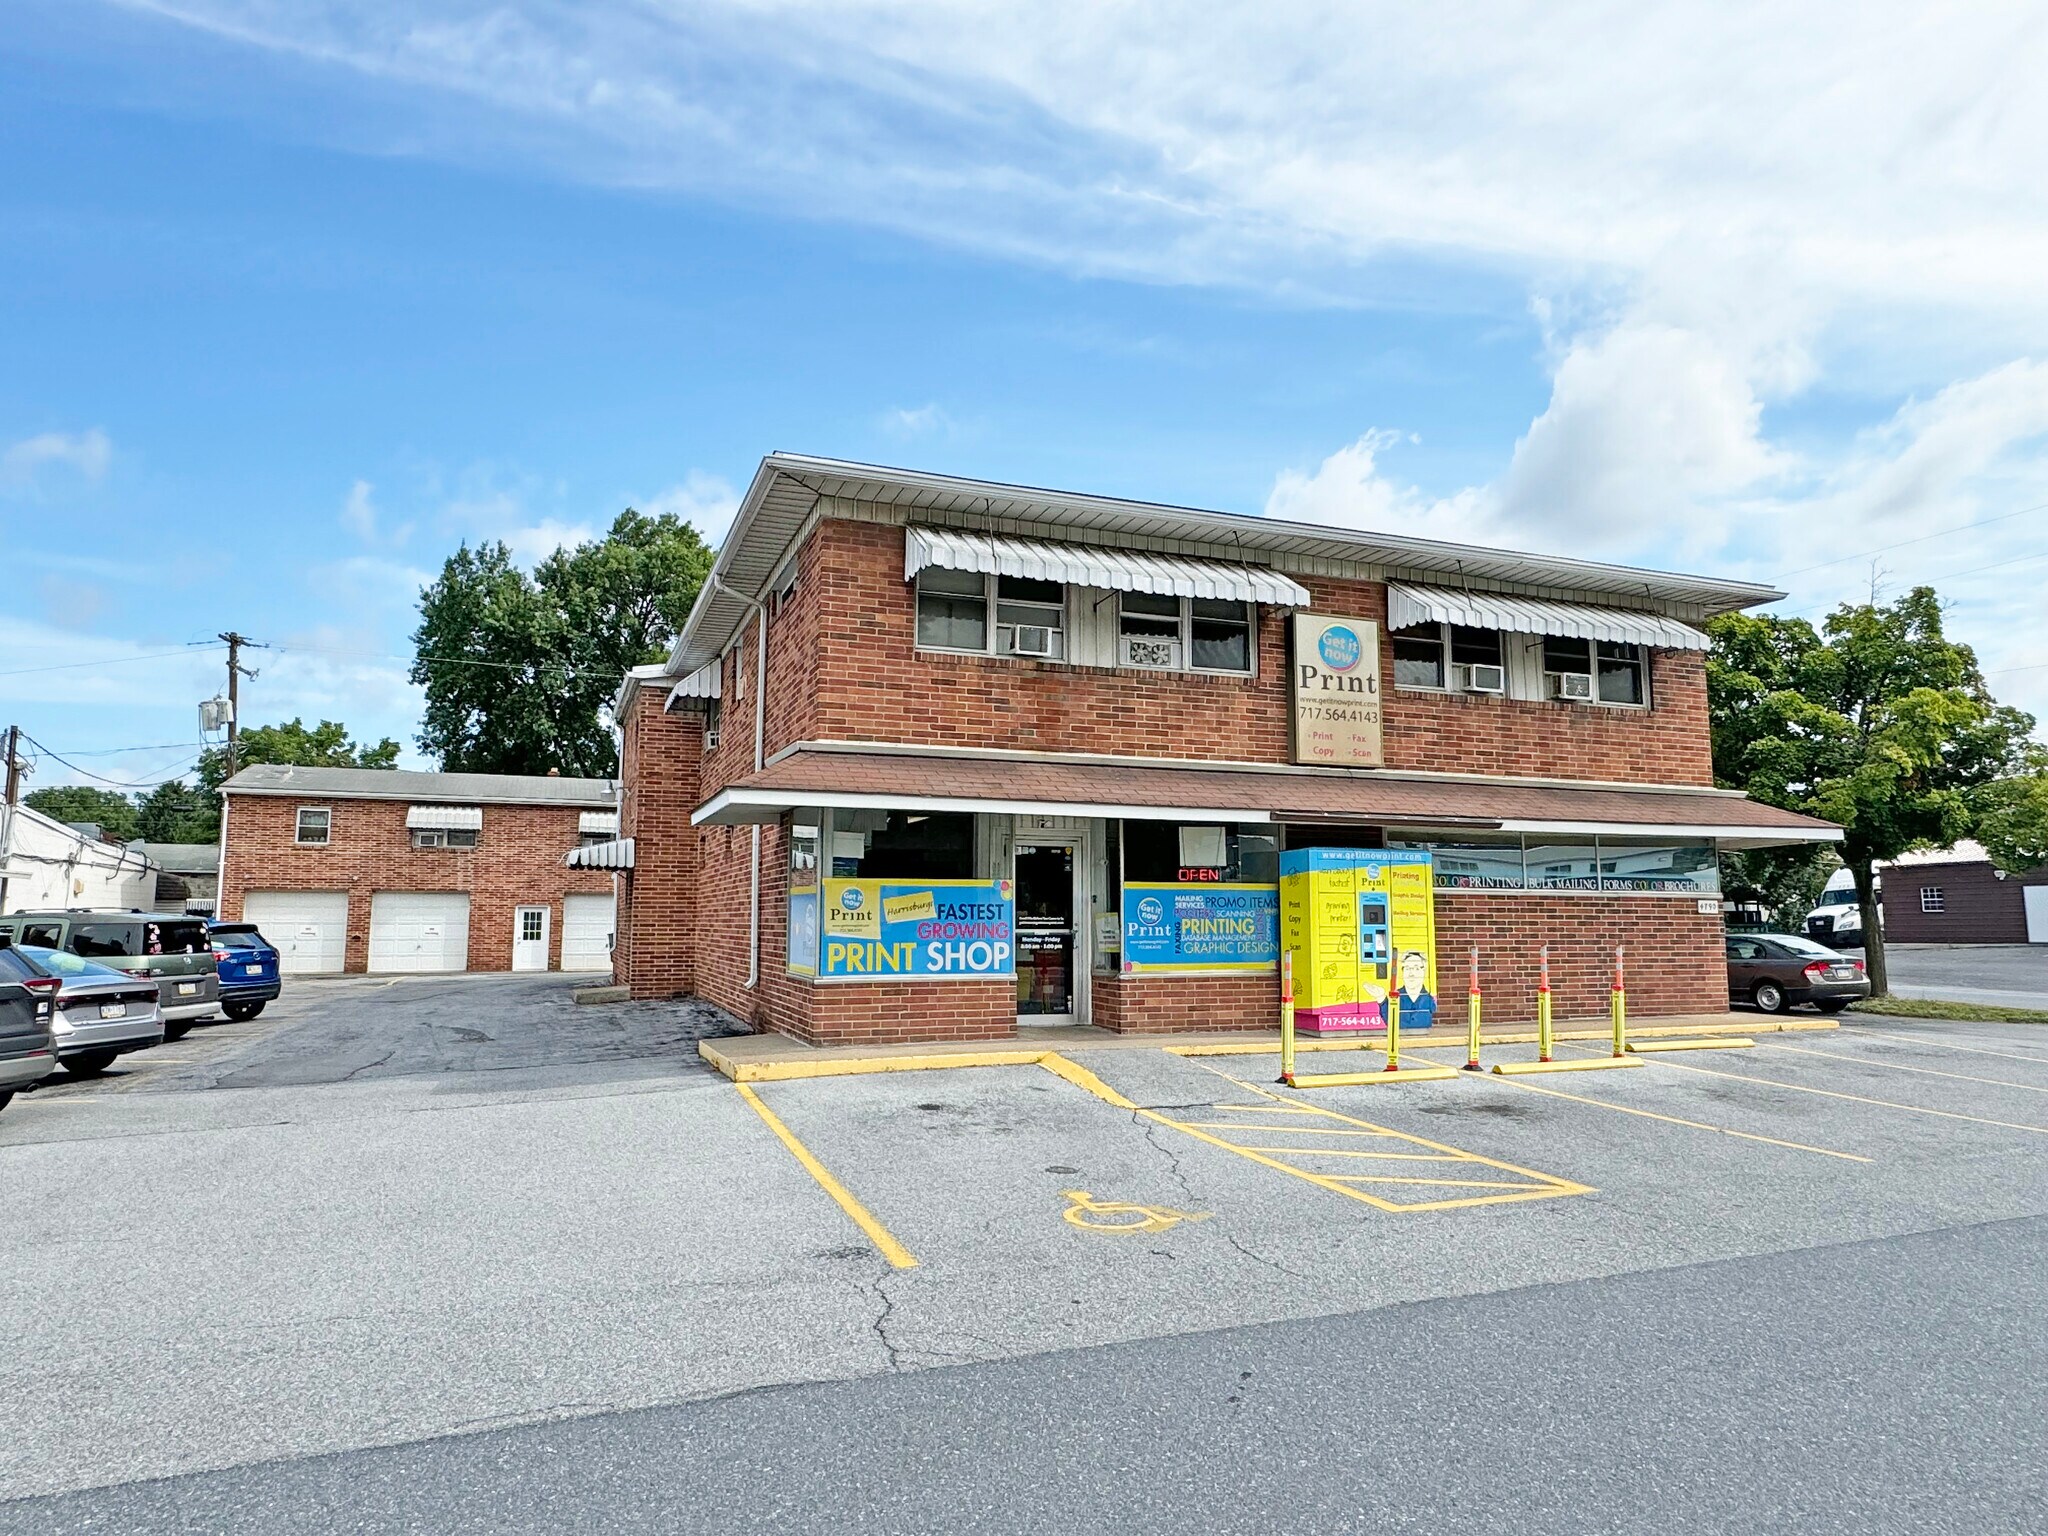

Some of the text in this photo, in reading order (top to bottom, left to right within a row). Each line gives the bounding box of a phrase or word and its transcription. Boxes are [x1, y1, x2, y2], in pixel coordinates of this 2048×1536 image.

[1322, 633, 1358, 652] Get it
[1324, 648, 1353, 663] now
[1299, 664, 1376, 694] Print
[1300, 696, 1378, 708] www.getitnowprint.com
[1300, 706, 1378, 724] 717.564.4143
[1312, 732, 1333, 740] Print
[1352, 734, 1366, 742] Fax
[1312, 746, 1334, 757] Copy
[1352, 749, 1372, 758] Scan
[1322, 852, 1422, 860] www.getitnowprint.com
[1178, 868, 1219, 880] OPEN
[1392, 872, 1420, 881] Printing
[1362, 878, 1386, 886] Print
[1469, 877, 1520, 888] PRINTING
[1528, 877, 1597, 890] BULK MAILING
[1604, 879, 1632, 890] FORMS
[1664, 880, 1716, 892] BROCHURES
[844, 892, 856, 900] Get
[844, 900, 860, 908] now
[1140, 903, 1154, 912] Get
[1206, 896, 1278, 908] PROMO ITEMS
[830, 908, 872, 920] Print
[938, 904, 1004, 920] FASTEST
[1142, 912, 1158, 920] now
[1216, 910, 1255, 918] SCANNING
[1288, 915, 1300, 924] Copy
[918, 922, 1010, 940] GROWING
[1128, 922, 1172, 936] Print
[1182, 918, 1254, 934] PRINTING
[1290, 928, 1300, 936] Fax
[1184, 942, 1279, 954] GRAPHIC DESIGN
[827, 942, 918, 972] PRINT
[926, 942, 1010, 971] SHOP
[1322, 1016, 1381, 1026] 717-564-4143
